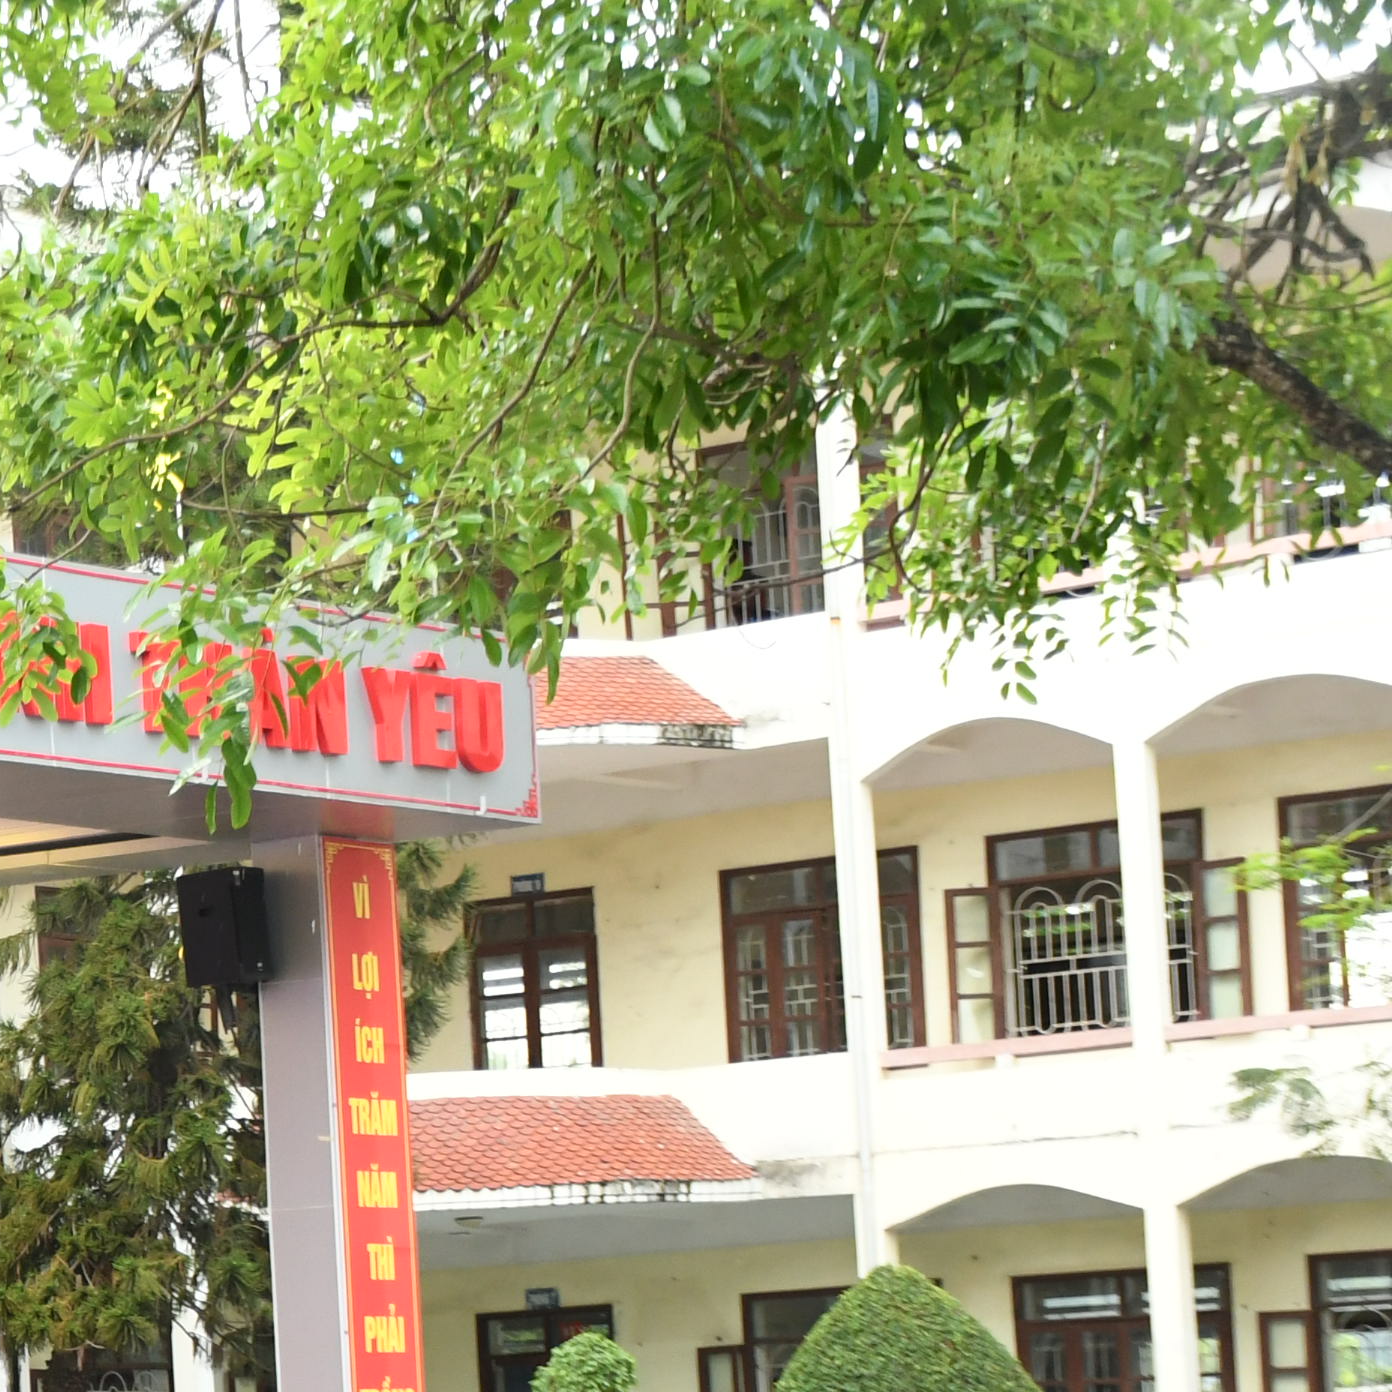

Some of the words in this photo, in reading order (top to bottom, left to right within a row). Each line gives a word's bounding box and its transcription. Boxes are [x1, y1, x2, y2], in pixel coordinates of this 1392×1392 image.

[362, 651, 505, 774] YÊU
[352, 875, 371, 919] VÌ
[352, 951, 380, 999] LỢI
[354, 1018, 385, 1064] ÍCH
[348, 1091, 398, 1137] TRĂM
[356, 1163, 398, 1209] NĂM
[367, 1236, 395, 1281] THÌ
[364, 1303, 406, 1353] PHẢI
